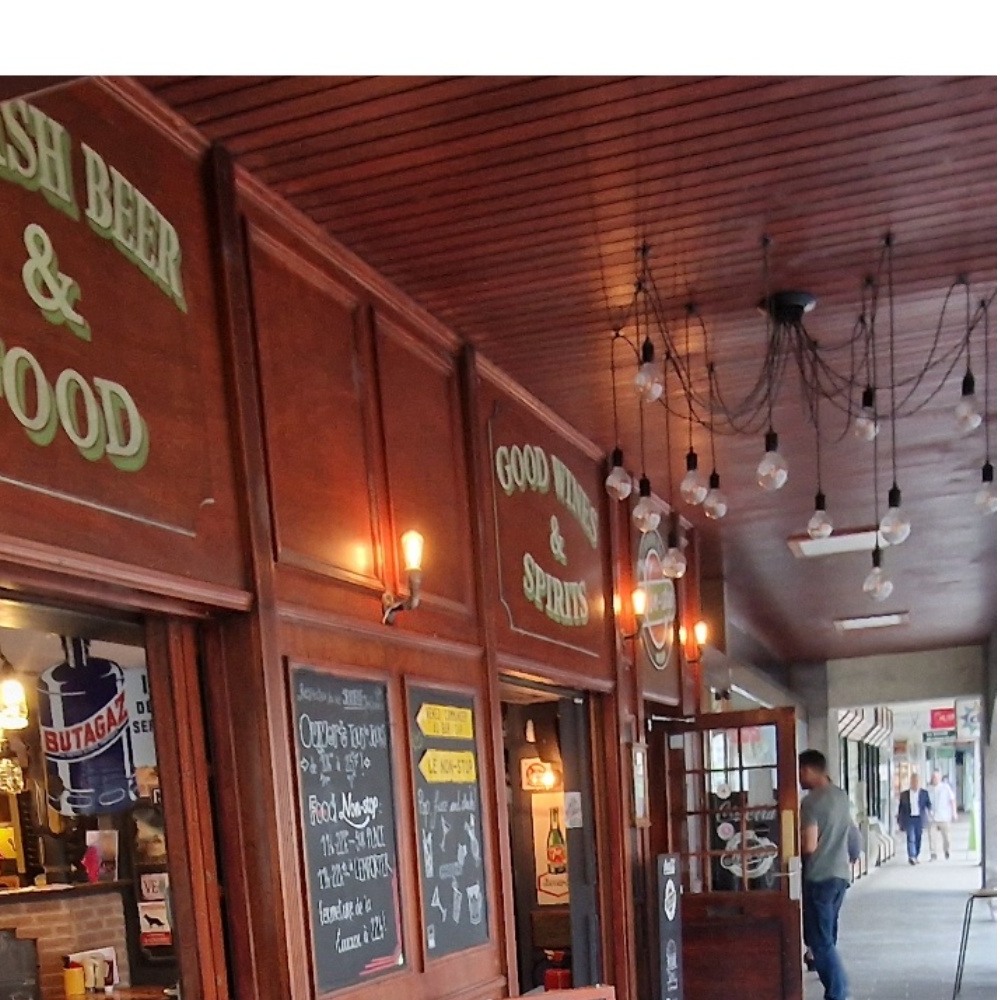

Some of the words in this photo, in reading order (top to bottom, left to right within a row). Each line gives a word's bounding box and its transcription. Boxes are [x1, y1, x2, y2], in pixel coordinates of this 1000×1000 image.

[81, 142, 188, 313] BEER
[21, 222, 92, 342] &
[496, 444, 549, 497] GOOD
[550, 514, 567, 566] &
[523, 552, 589, 627] SPIRITS
[45, 691, 129, 753] BUTAGAZ
